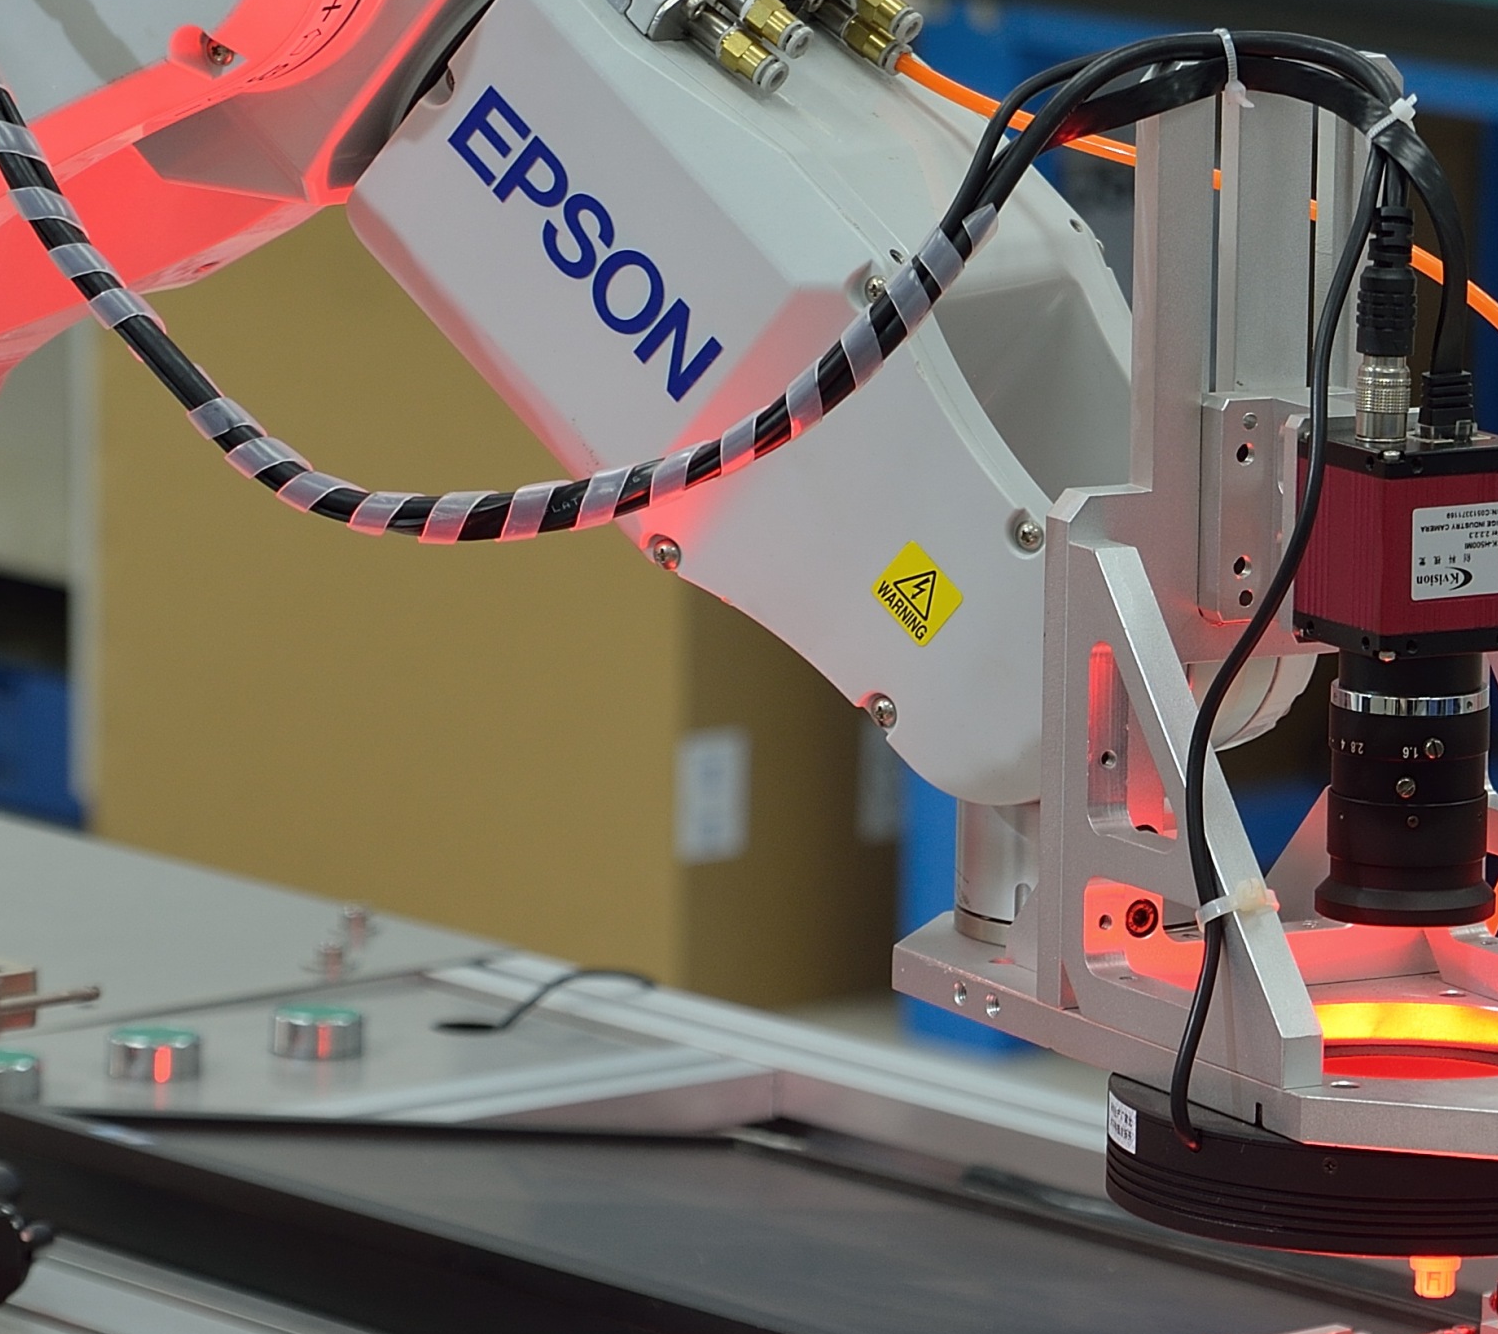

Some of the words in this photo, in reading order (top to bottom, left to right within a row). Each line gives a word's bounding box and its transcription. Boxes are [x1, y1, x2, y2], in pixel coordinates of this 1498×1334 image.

[447, 85, 724, 403] EPSON
[1420, 524, 1450, 533] CAMERA
[1451, 520, 1486, 530] INDUSTRY
[877, 579, 928, 641] WARNING
[1402, 745, 1419, 759] 1.6
